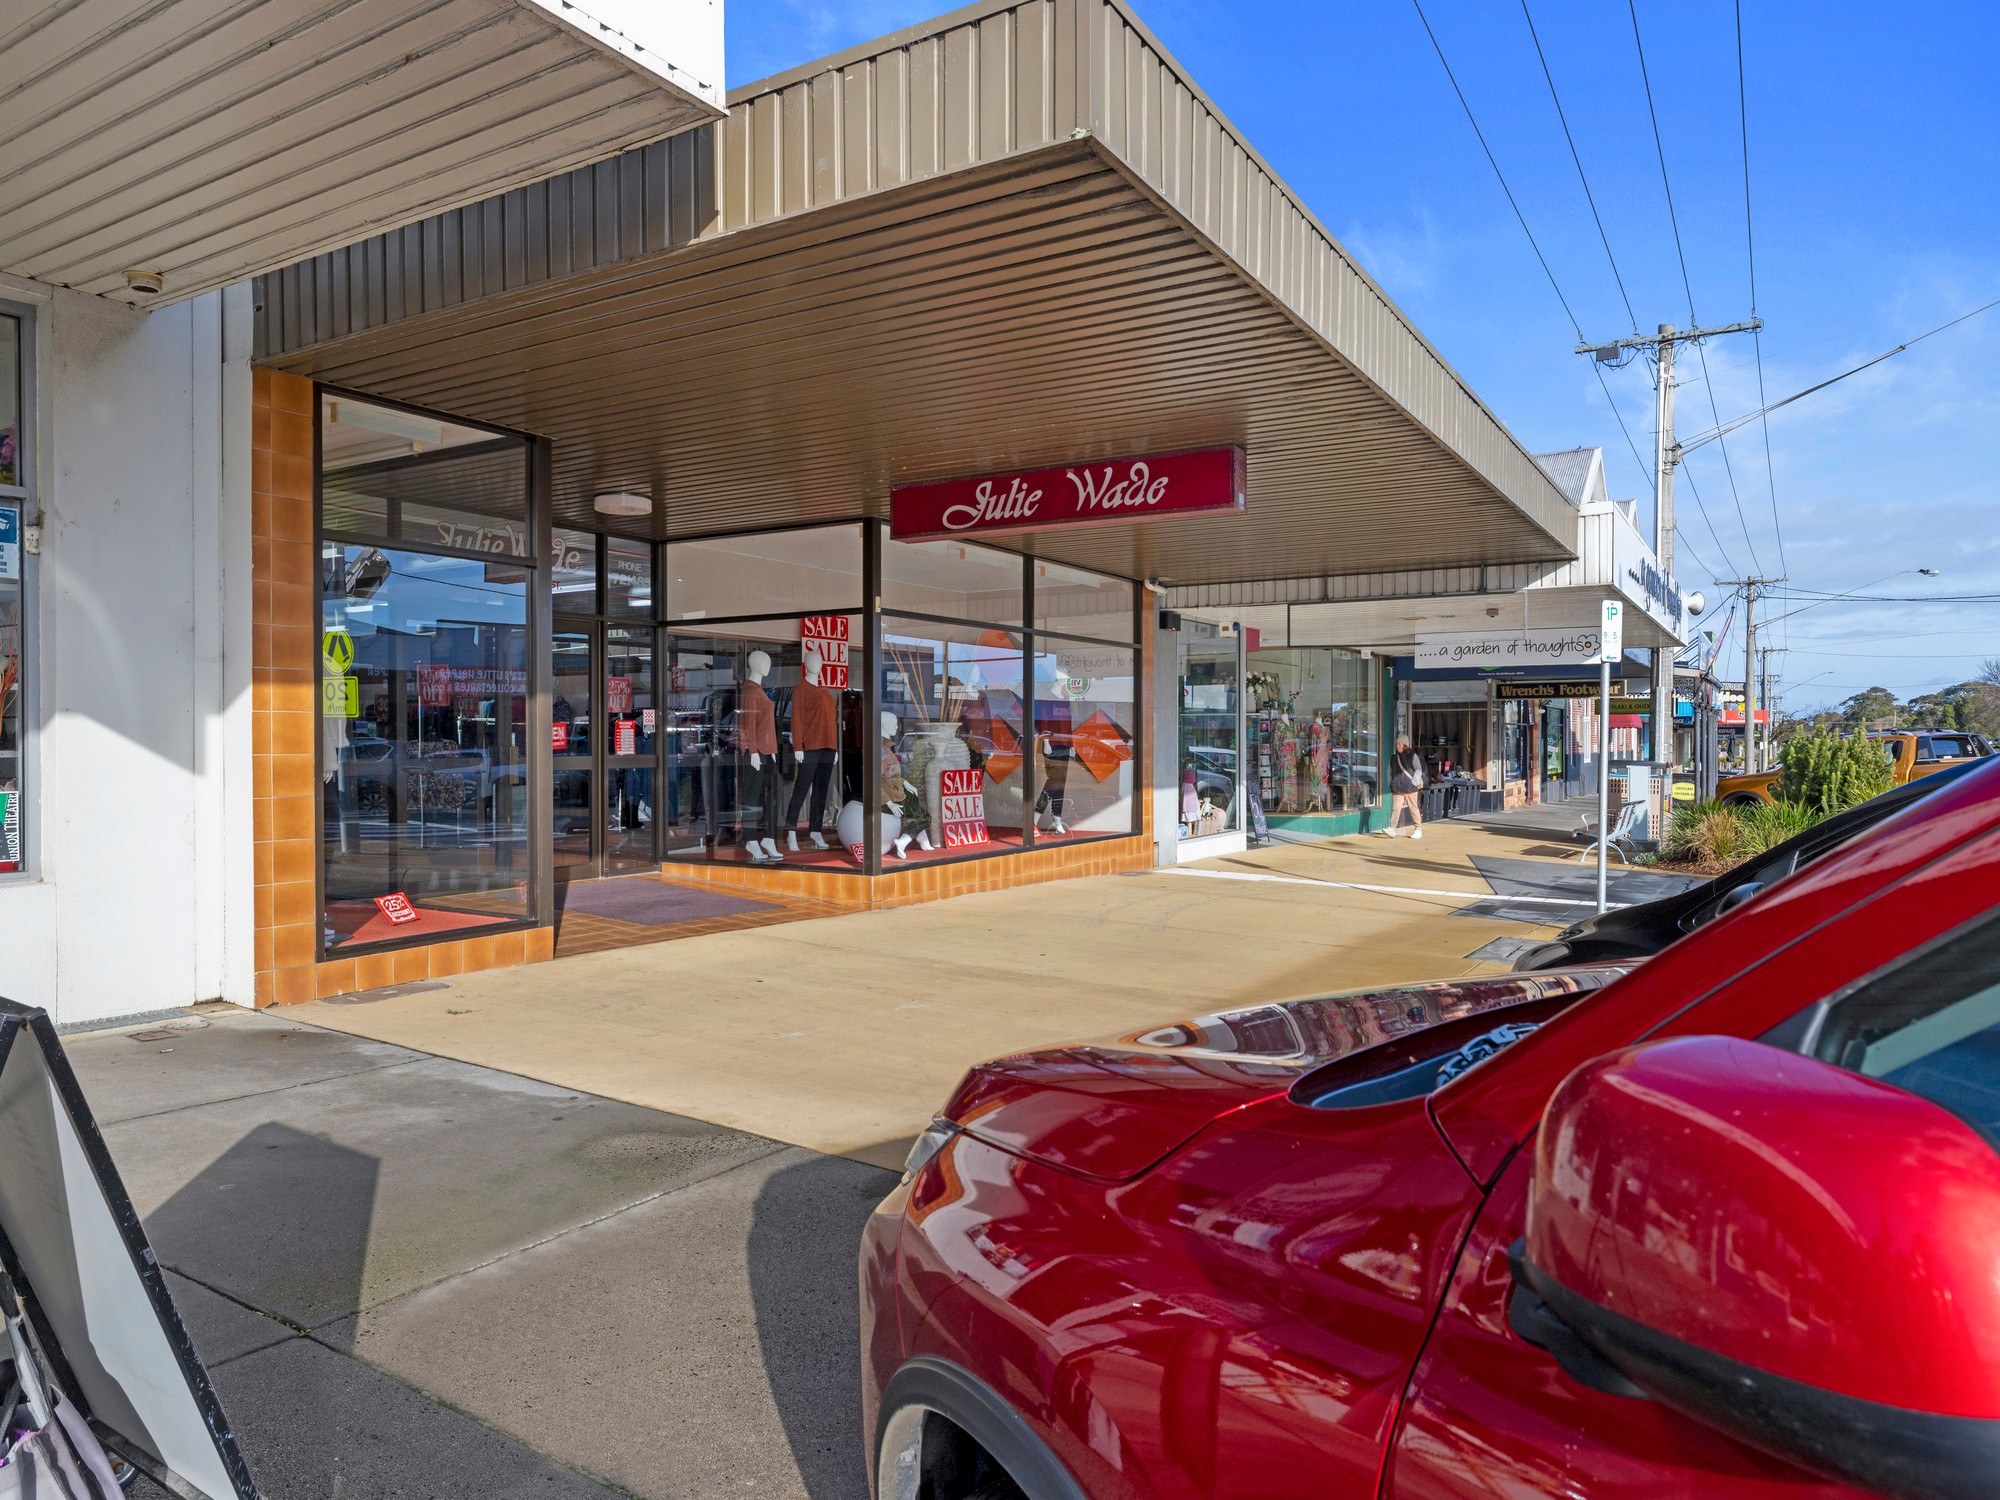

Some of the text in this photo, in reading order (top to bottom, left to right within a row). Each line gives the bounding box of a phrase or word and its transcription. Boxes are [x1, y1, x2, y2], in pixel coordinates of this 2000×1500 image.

[942, 462, 1169, 529] Julie Wade
[618, 561, 642, 572] PHONE
[1607, 607, 1618, 620] 1P
[804, 617, 847, 639] SALE
[805, 640, 847, 663] SALE
[1451, 641, 1500, 661] garden
[1507, 639, 1519, 655] of
[1523, 636, 1584, 657] thoughts
[608, 681, 630, 694] 25%
[815, 666, 847, 688] ALE
[610, 694, 627, 708] OFF
[1501, 684, 1621, 697] Wrench's Footwar
[552, 726, 564, 740] EN
[944, 771, 981, 794] SALE
[944, 797, 982, 820] SALE
[4, 792, 18, 860] UNION THEATRE
[946, 821, 988, 847] SALE
